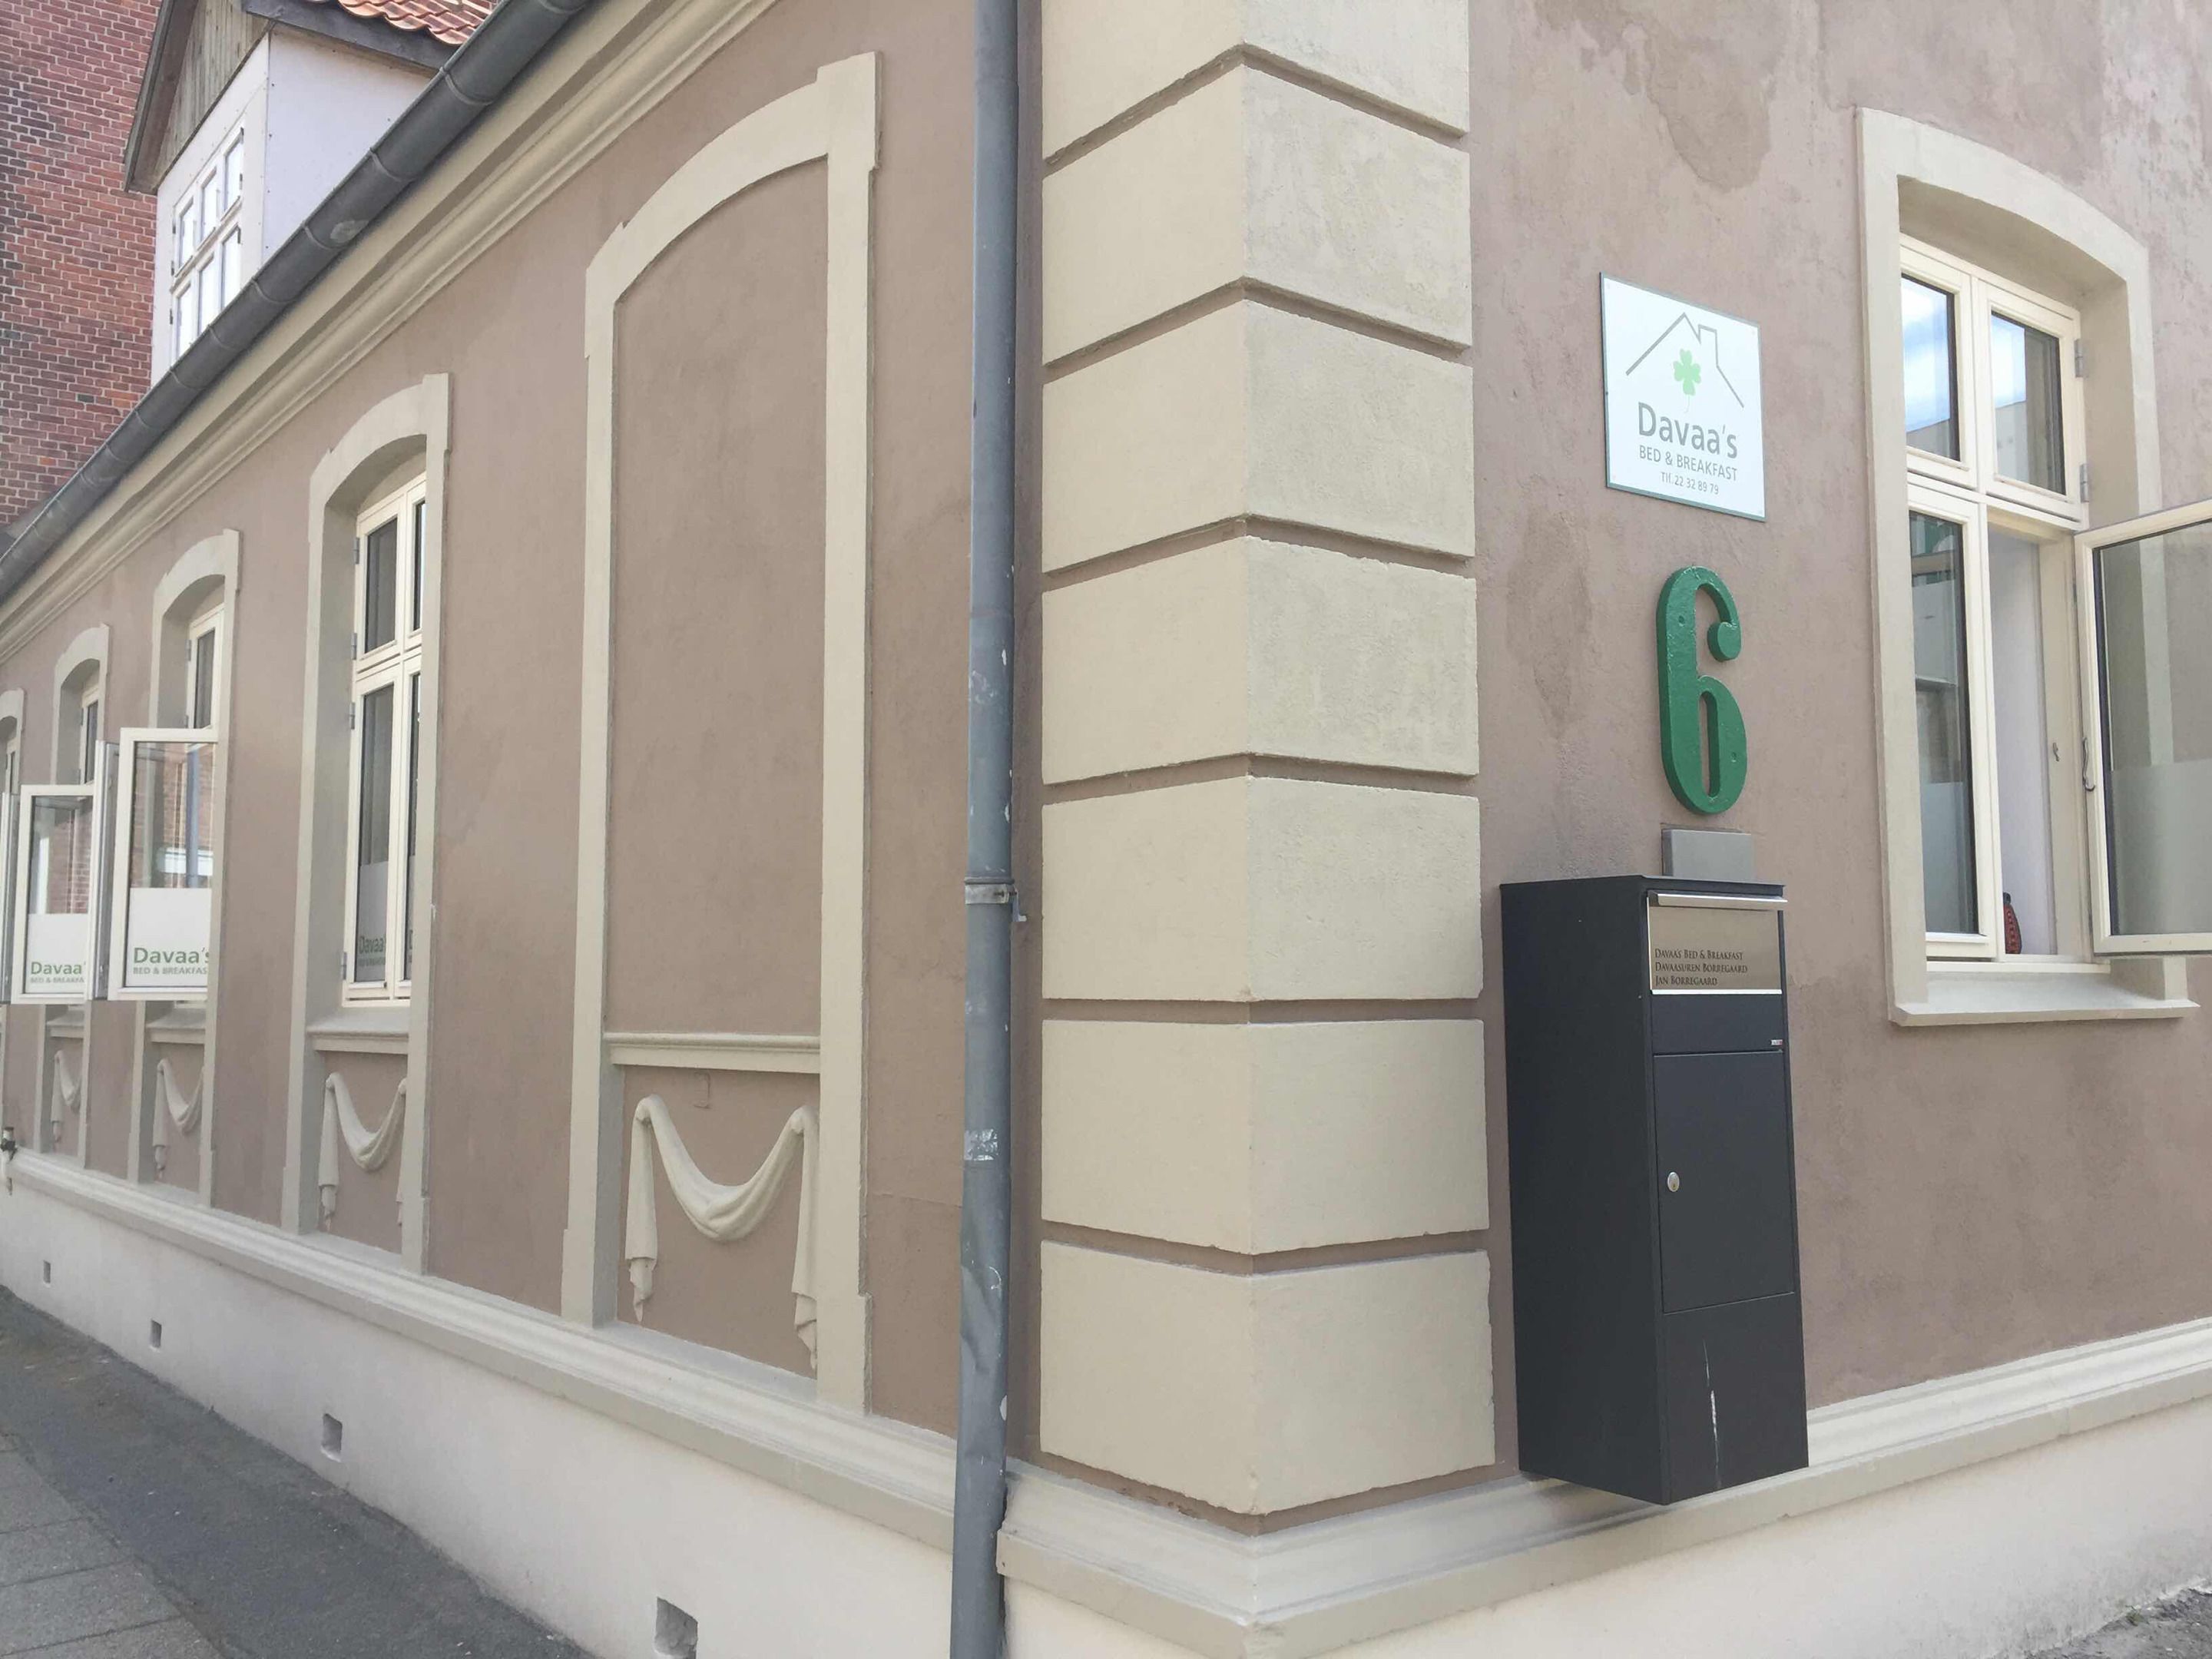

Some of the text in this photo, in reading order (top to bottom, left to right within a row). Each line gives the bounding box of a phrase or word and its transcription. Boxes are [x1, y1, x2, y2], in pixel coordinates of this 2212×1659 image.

[1638, 402, 1737, 459] Davaa's
[1639, 445, 1737, 482] BED & BREAKFAST
[1686, 477, 1696, 490] 32
[1697, 480, 1707, 492] 89
[1710, 483, 1719, 495] 79
[1656, 566, 1747, 815] 6
[359, 936, 386, 954] Davaa
[1700, 949, 1705, 959] &
[31, 961, 86, 975] Davaa'
